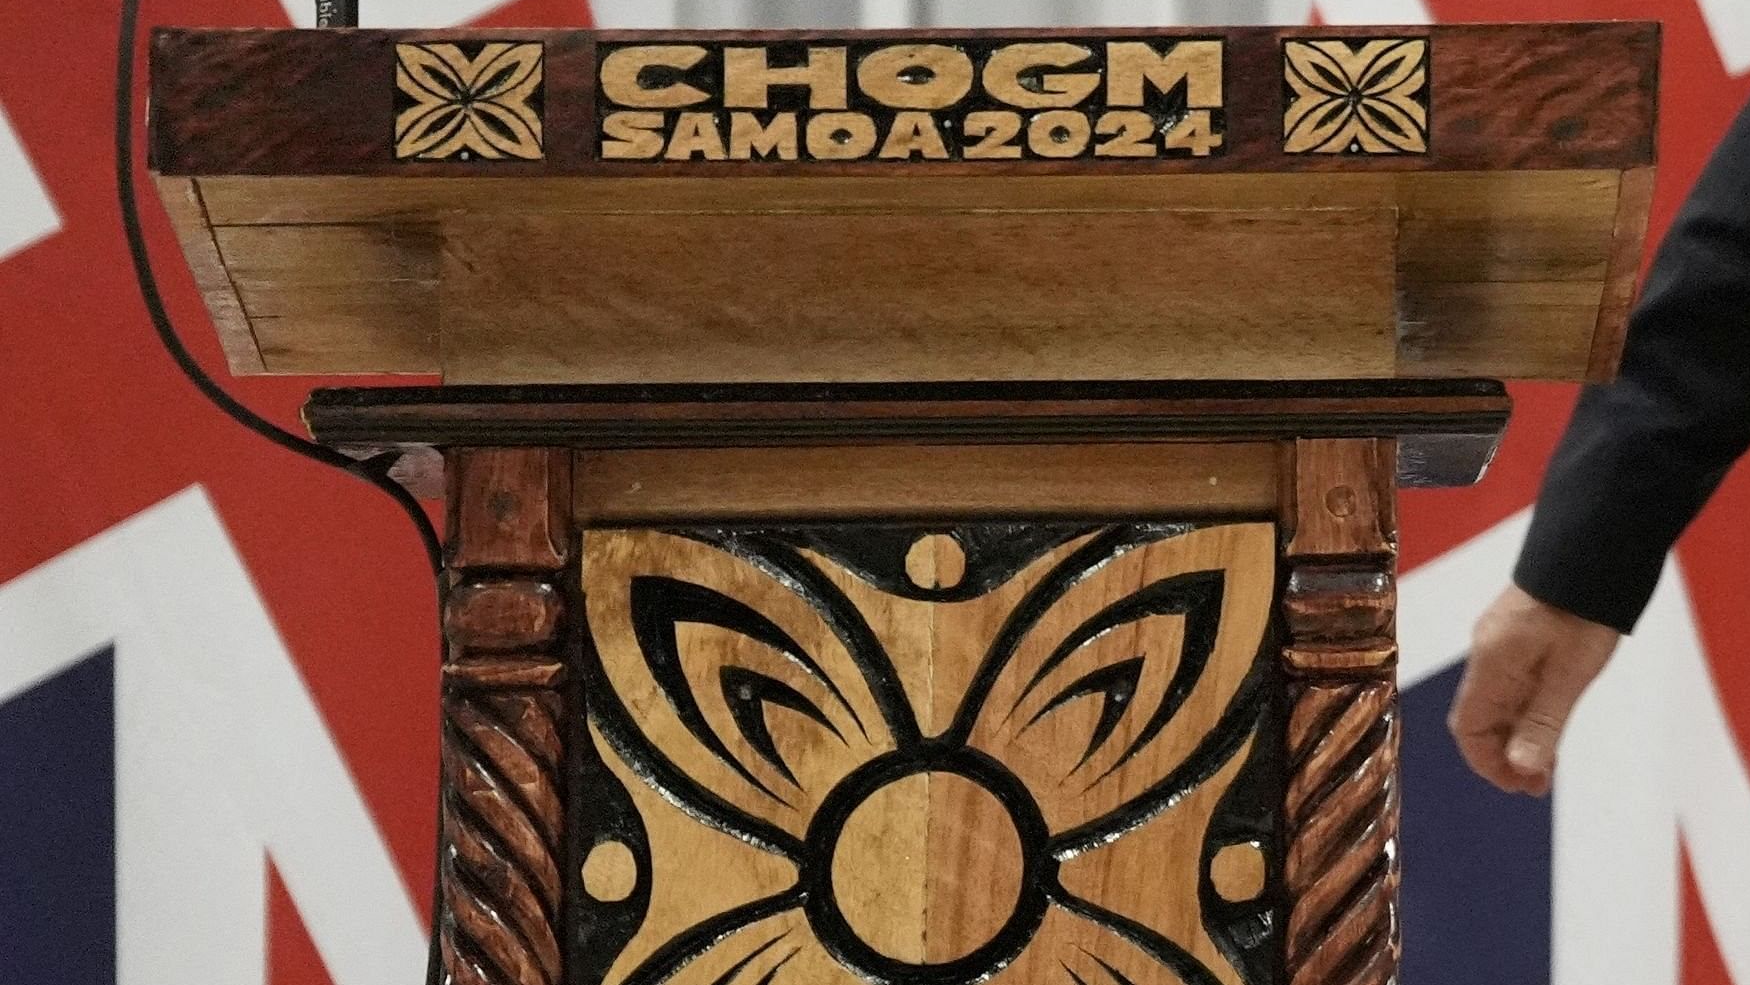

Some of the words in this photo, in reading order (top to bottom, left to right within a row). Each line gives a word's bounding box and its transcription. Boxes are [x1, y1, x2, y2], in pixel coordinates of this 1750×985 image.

[600, 41, 1223, 109] CHOGM
[601, 111, 950, 160] SAMOA
[963, 109, 1223, 159] 2024
